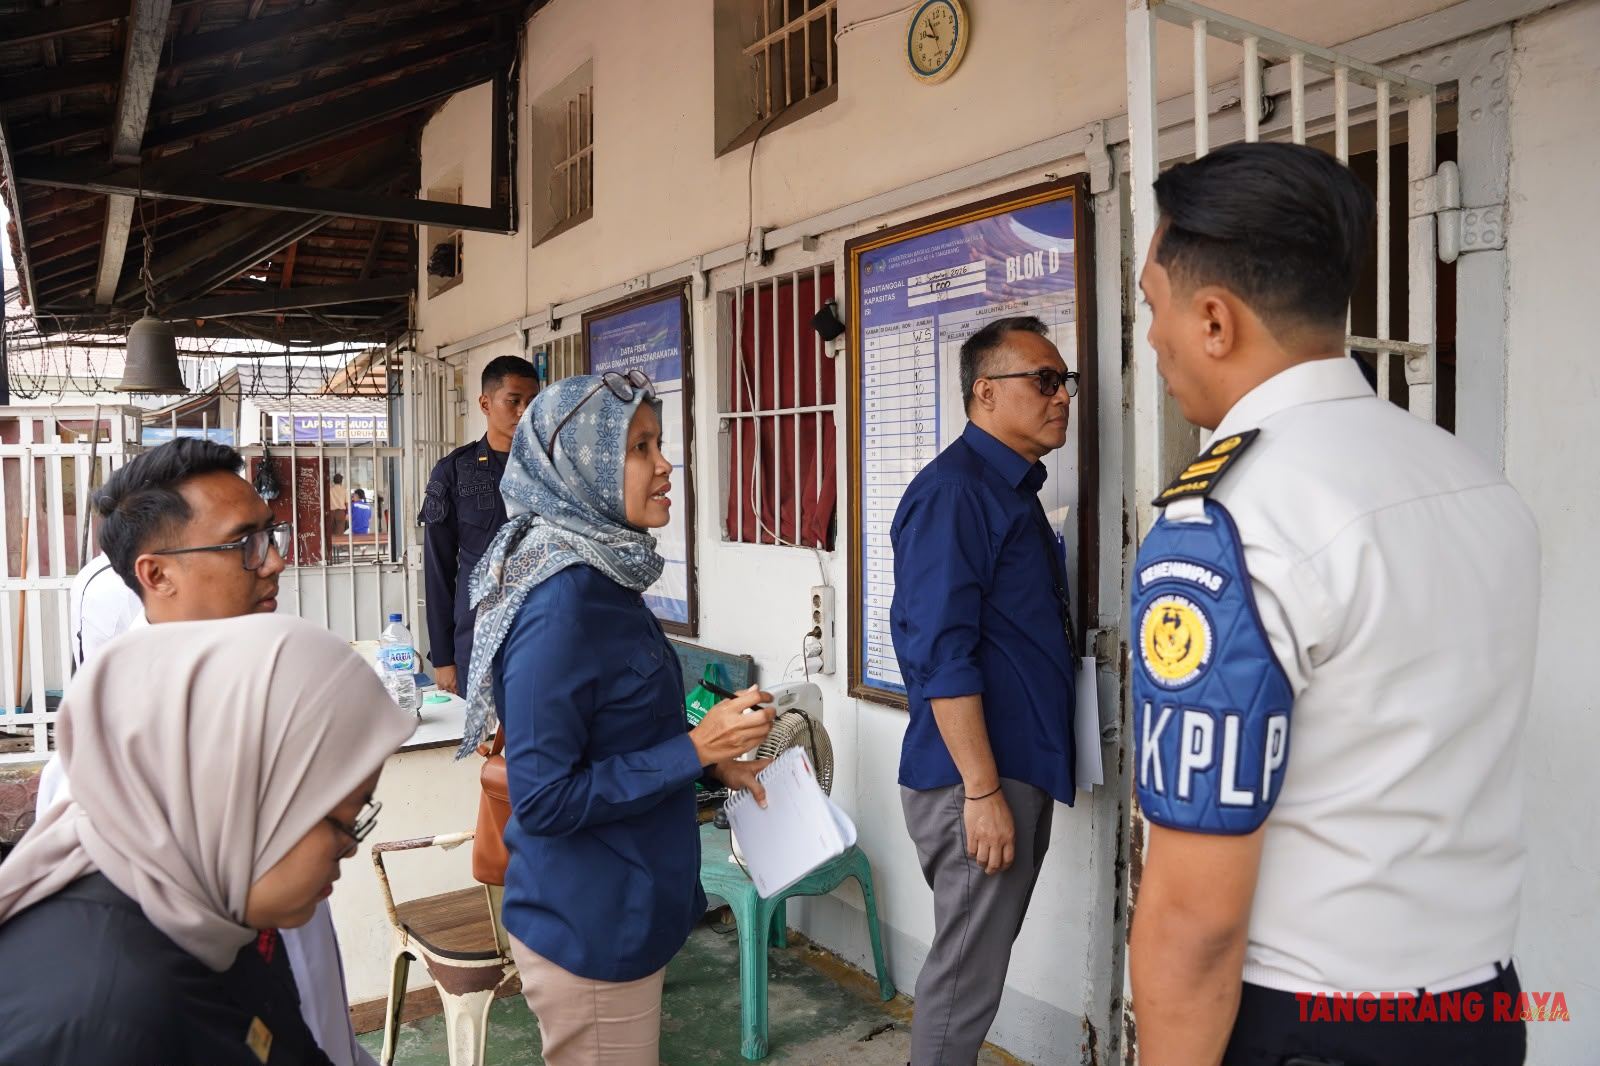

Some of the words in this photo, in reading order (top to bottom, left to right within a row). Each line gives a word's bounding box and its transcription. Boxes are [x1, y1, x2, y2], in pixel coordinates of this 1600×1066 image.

[932, 10, 940, 20] 12
[1006, 250, 1044, 283] BLOK
[1048, 247, 1060, 274] D
[864, 293, 896, 305] KAPASITAS
[621, 347, 634, 356] DATA
[634, 344, 647, 353] FISIK
[596, 361, 611, 371] WARGA
[612, 358, 628, 369] BINAAN
[630, 347, 678, 364] PEMASYARAKATAN
[302, 420, 334, 429] LAPAS
[335, 420, 373, 429] PEMUDA
[390, 652, 412, 662] AQUA
[1141, 702, 1288, 806] KPLP
